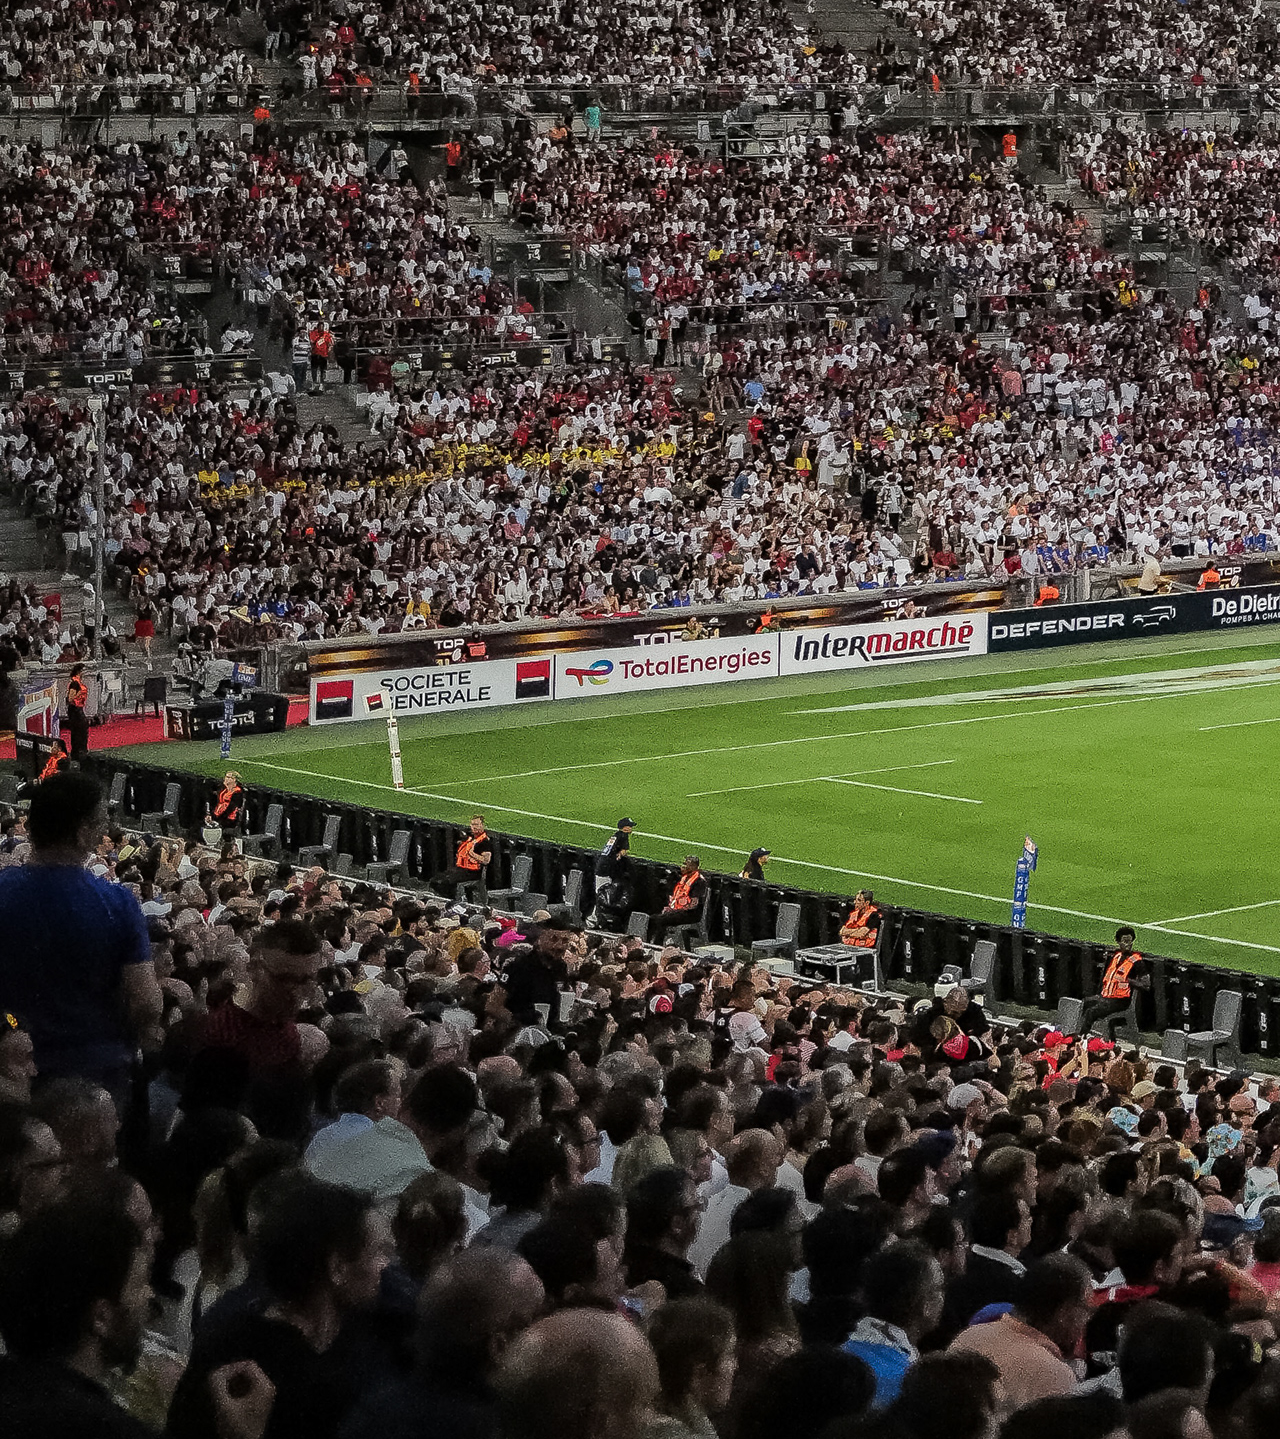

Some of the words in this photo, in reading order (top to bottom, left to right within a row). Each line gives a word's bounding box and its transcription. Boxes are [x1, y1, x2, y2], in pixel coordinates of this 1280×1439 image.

[1212, 596, 1238, 618] De
[991, 613, 1125, 640] DEFENDER
[1221, 615, 1252, 625] POMPES
[619, 647, 772, 679] TotalEnergies
[380, 670, 472, 692] SOCIETE
[390, 686, 491, 710] ENERALE
